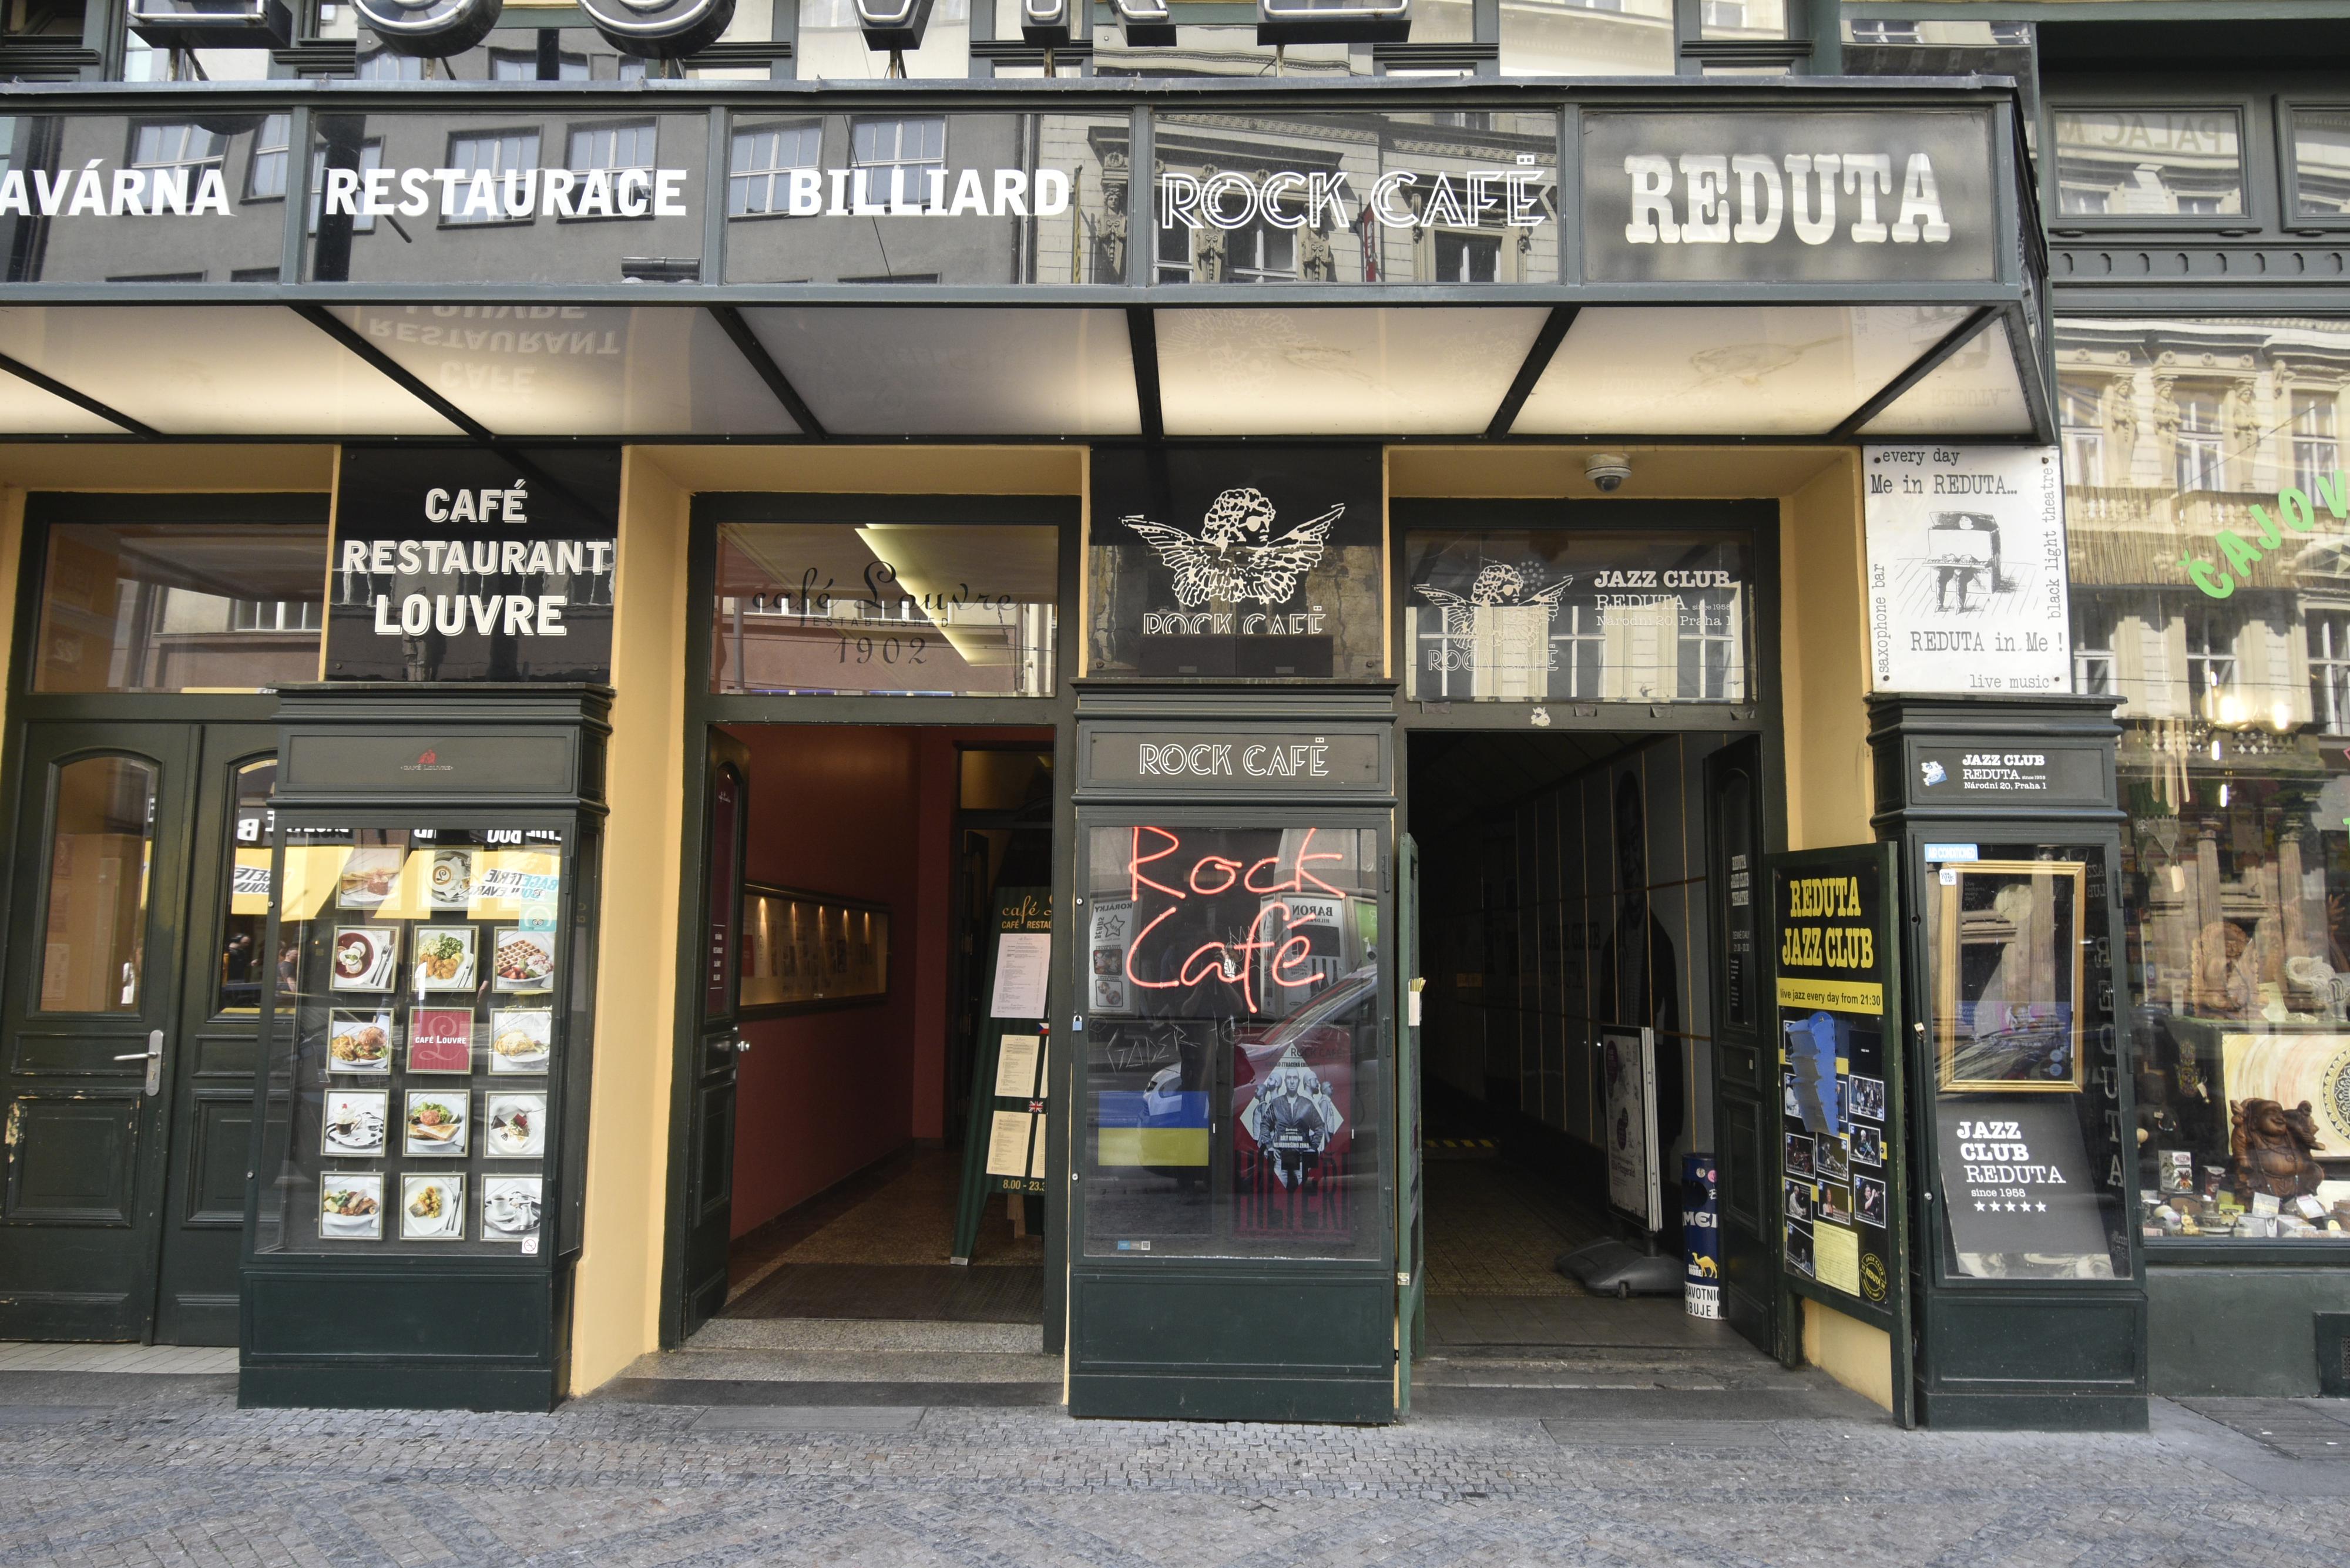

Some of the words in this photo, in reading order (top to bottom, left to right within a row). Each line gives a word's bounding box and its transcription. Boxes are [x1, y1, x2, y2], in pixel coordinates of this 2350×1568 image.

[324, 167, 687, 216] RESTAURACE
[790, 169, 1069, 216] BILLIARD
[1162, 172, 1350, 229] ROCK
[1624, 152, 1951, 245] REDUTA
[1883, 450, 1925, 466] every
[1933, 448, 1960, 466] day
[1871, 474, 1893, 495] Me
[1903, 474, 1923, 494] in
[2040, 467, 2055, 523] theatre
[425, 479, 528, 523] CAFÉ
[342, 539, 612, 575] RESTAURANT
[2043, 530, 2062, 573] light
[1594, 570, 1657, 588] JAZZ
[1663, 570, 1731, 588] CLUB
[1872, 564, 1885, 589] bar
[752, 567, 840, 627] café
[854, 560, 1022, 612] Louvre
[1594, 594, 1688, 610] REDUTA
[2045, 578, 2061, 619] black
[374, 593, 568, 636] LOUVRE
[813, 616, 950, 628] ESTABLISHED
[1143, 613, 1233, 634] ROCK
[1680, 615, 1723, 627] Praha
[1725, 615, 1732, 626] 1
[1874, 596, 1891, 673] saxophone
[1911, 631, 1985, 652] REDUTA
[1995, 632, 2015, 652] in
[2026, 632, 2048, 652] Me
[834, 636, 927, 665] 1902
[1970, 674, 2001, 689] live
[2009, 675, 2050, 689] music
[1140, 743, 1233, 775] ROCK
[1962, 754, 2000, 765] JAZZ
[2004, 754, 2045, 766] CLUB
[1963, 768, 2021, 780] REDUTA
[1964, 781, 1998, 790] Národní
[2000, 781, 2013, 791] 20,
[2015, 781, 2040, 790] Praha
[2042, 781, 2047, 790] 1
[1790, 877, 1861, 917] REDUTA
[1002, 895, 1040, 924] café
[1002, 920, 1019, 929] CAFÉ
[1782, 928, 1822, 966] JAZZ
[1825, 927, 1874, 969] CLUB
[1780, 988, 1791, 999] live
[1792, 989, 1805, 1001] jazz
[1807, 990, 1825, 1003] every
[1827, 991, 1839, 1005] day
[1841, 992, 1858, 1005] from
[1861, 993, 1881, 1006] 21:30
[415, 1036, 434, 1044] CAFÉ
[1956, 1121, 2022, 1139] JAZZ
[1960, 1143, 2029, 1161] CLUB
[1003, 1179, 1021, 1189] 8.00
[1963, 1165, 2067, 1184] REDUTA
[1971, 1188, 1998, 1198] since
[2000, 1188, 2026, 1198] 1958
